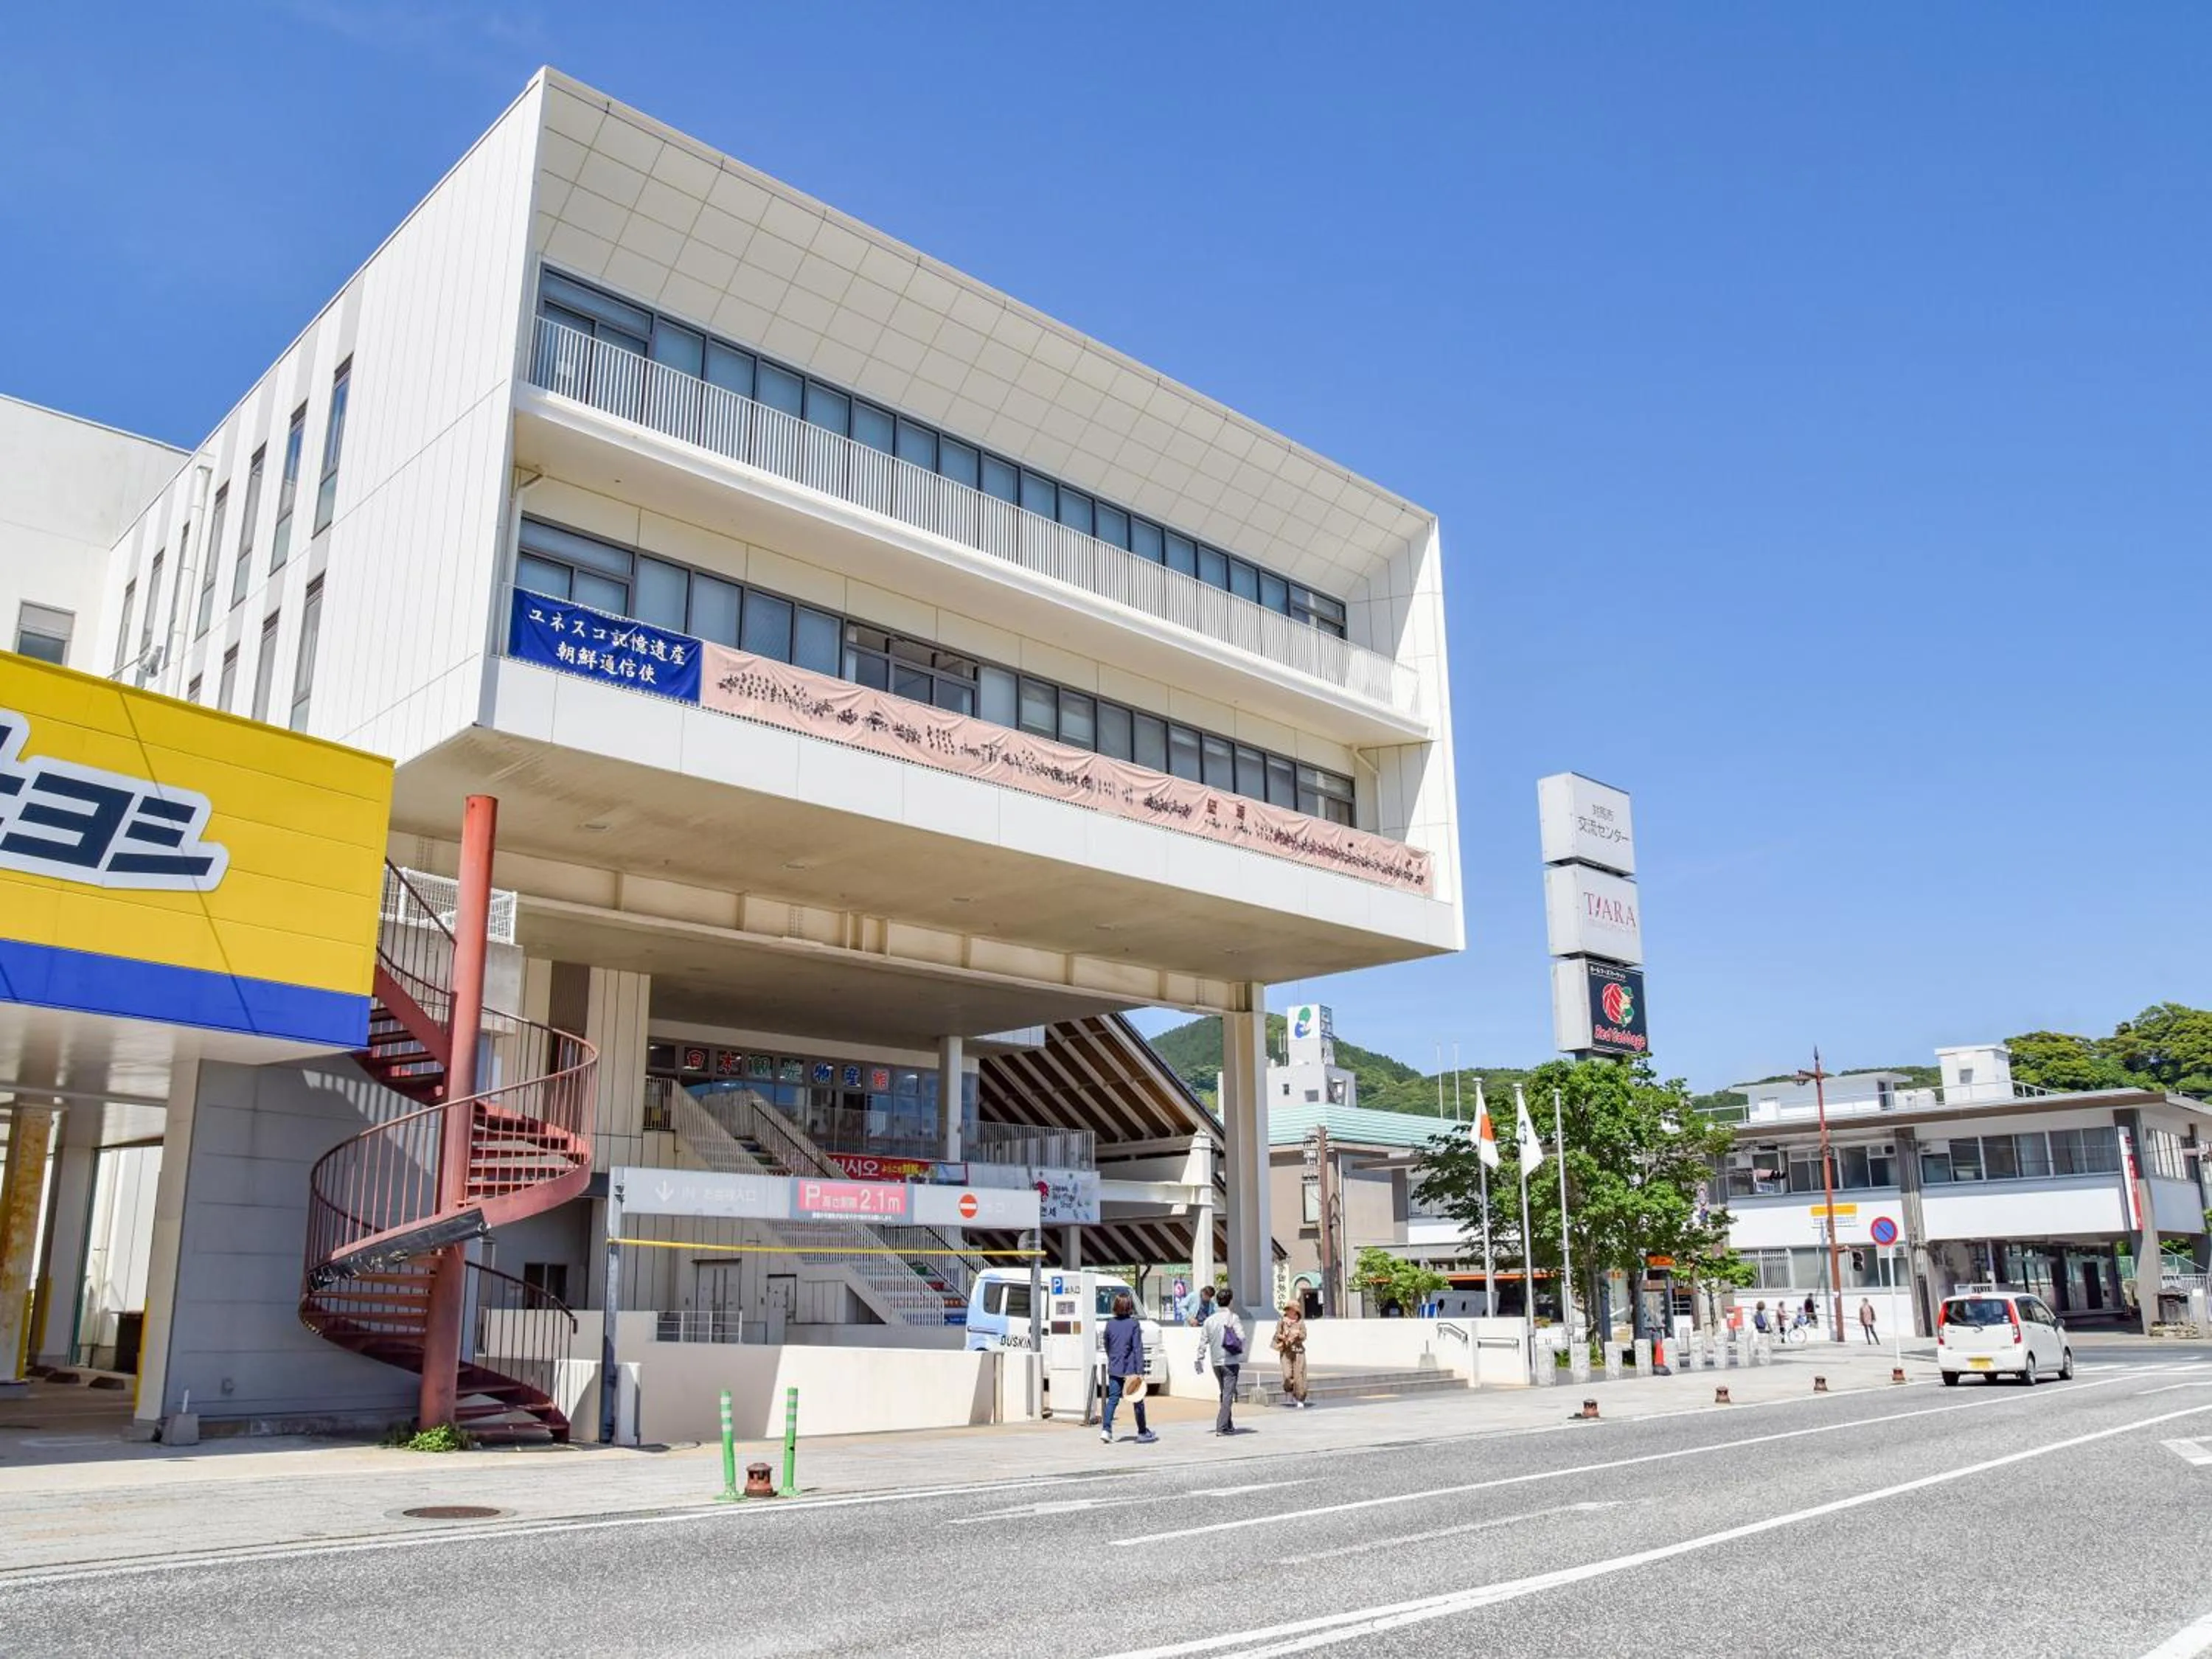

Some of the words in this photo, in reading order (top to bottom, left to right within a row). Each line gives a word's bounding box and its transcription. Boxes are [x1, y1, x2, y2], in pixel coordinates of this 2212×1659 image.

[529, 608, 686, 665] ユネスコ記憶遺産
[556, 641, 657, 685] 朝鮮通信使
[0, 725, 215, 877] ヨシ
[1577, 815, 1630, 843] 交流センター
[1583, 891, 1636, 928] TIARA
[805, 1183, 820, 1208] P
[860, 1189, 901, 1213] 2.1m
[1054, 1279, 1061, 1293] P
